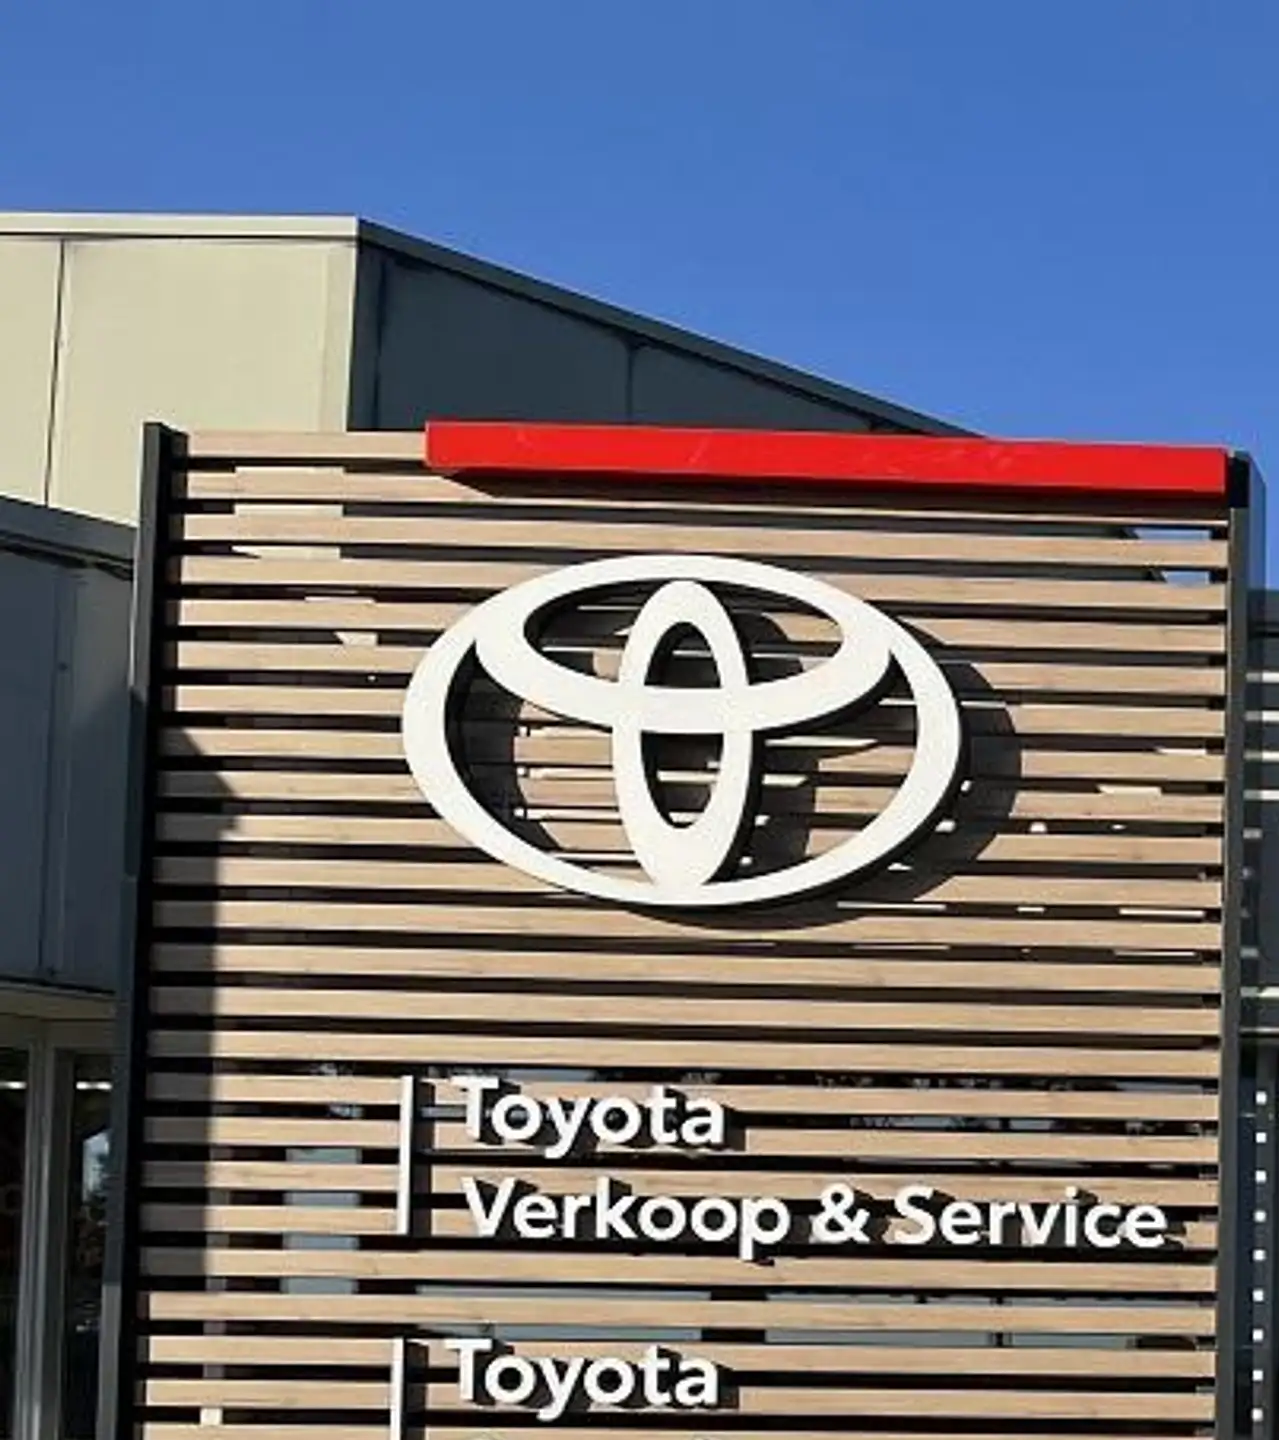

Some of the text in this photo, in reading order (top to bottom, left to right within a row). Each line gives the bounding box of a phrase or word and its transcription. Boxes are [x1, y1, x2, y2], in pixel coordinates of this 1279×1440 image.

[450, 1074, 726, 1159] Toyota
[460, 1174, 1167, 1261] Verkoop & Service
[443, 1337, 720, 1422] Toyota
